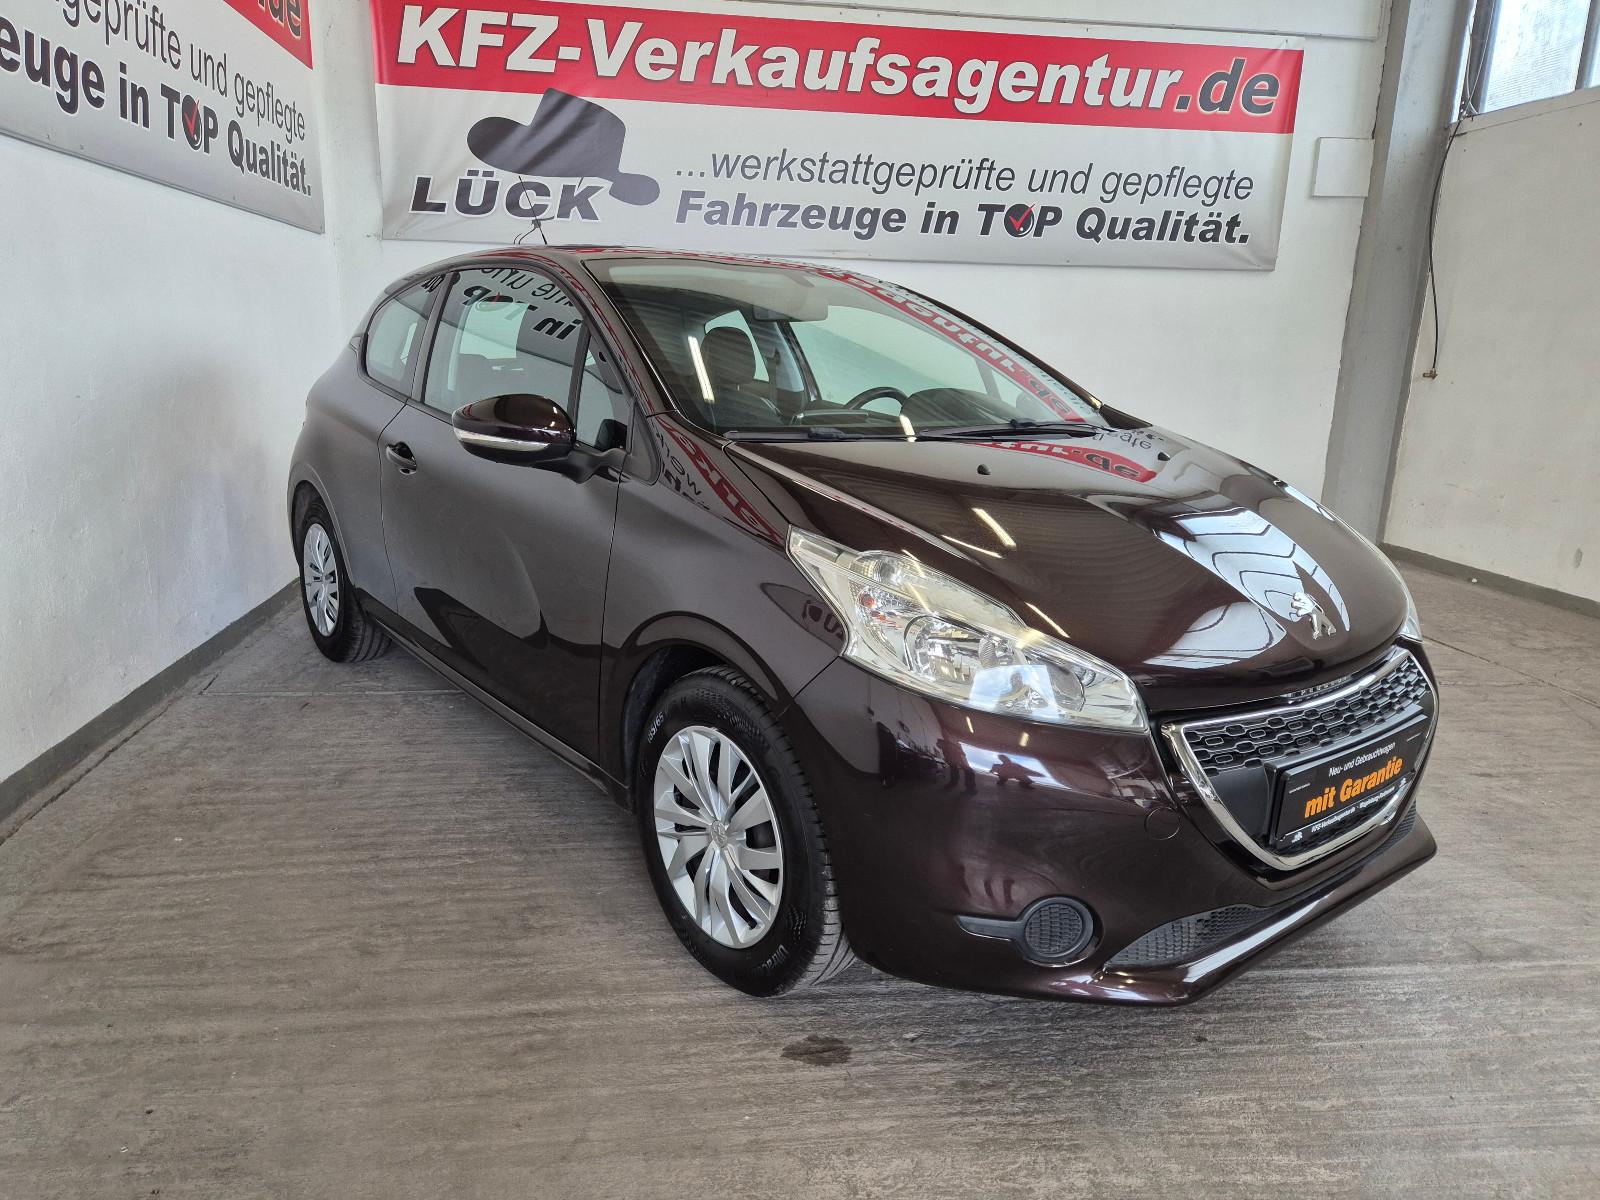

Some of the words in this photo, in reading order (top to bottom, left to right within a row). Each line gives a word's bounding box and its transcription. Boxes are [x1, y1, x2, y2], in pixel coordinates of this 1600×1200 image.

[397, 4, 1280, 117] KFZ-Verkaufsagentur.de
[190, 43, 228, 98] und
[234, 72, 306, 145] gepflegte
[119, 61, 150, 129] in
[160, 83, 219, 154] TOP
[227, 119, 312, 197] Qualität.
[409, 169, 605, 222] LÜCK
[1027, 163, 1093, 195] und
[1100, 166, 1254, 206] gepflegte
[674, 189, 907, 240] Fahrzeuge
[920, 201, 960, 236] in
[976, 203, 1063, 239] TOP
[1075, 207, 1251, 245] Qualität.
[1304, 785, 1336, 819] mit
[1339, 756, 1403, 803] Garantie
